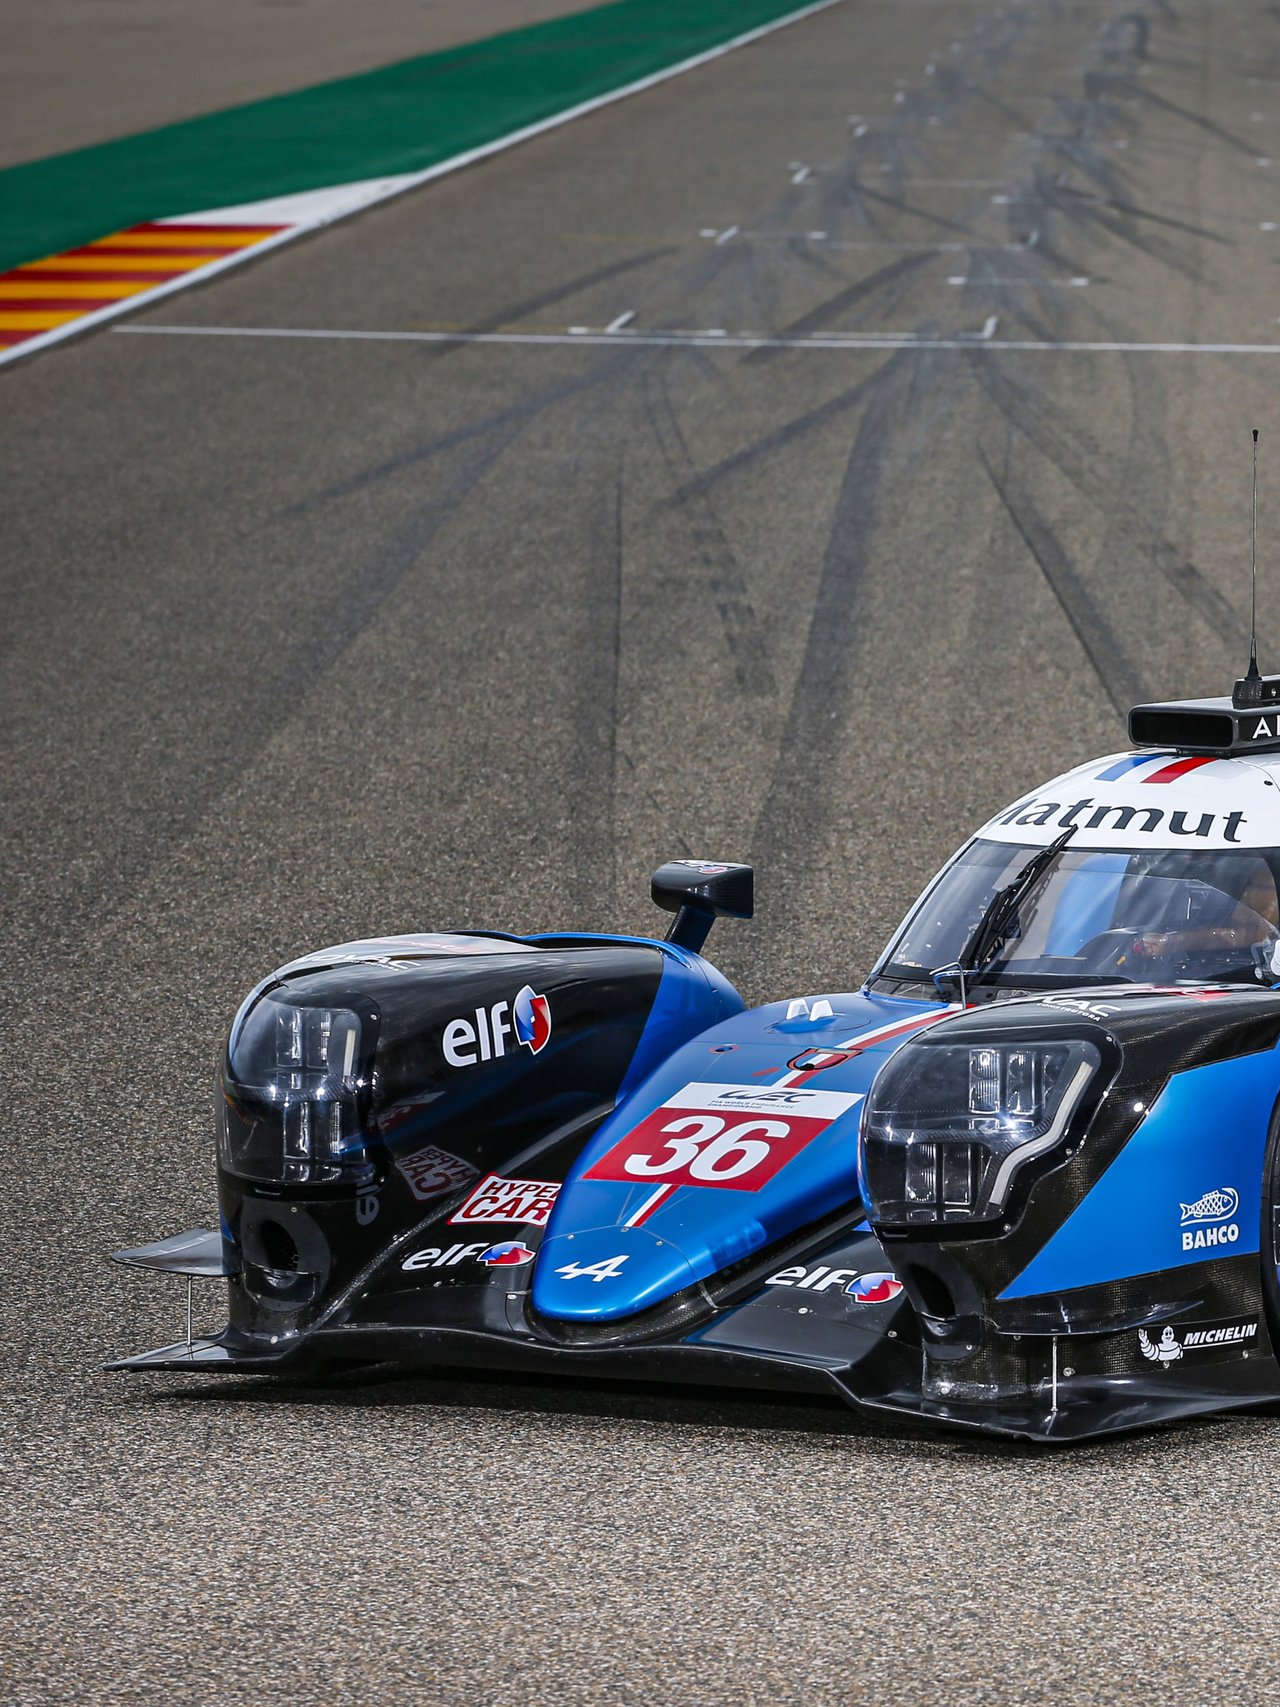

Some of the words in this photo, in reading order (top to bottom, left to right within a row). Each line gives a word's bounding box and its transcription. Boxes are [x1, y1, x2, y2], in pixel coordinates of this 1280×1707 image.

[442, 1000, 511, 1067] elf
[623, 1115, 791, 1181] 36
[462, 1196, 555, 1221] CAR
[1182, 1223, 1239, 1251] BAHCO
[401, 1242, 490, 1271] elf
[764, 1266, 858, 1291] elf
[1183, 1323, 1258, 1346] MICHELIN
